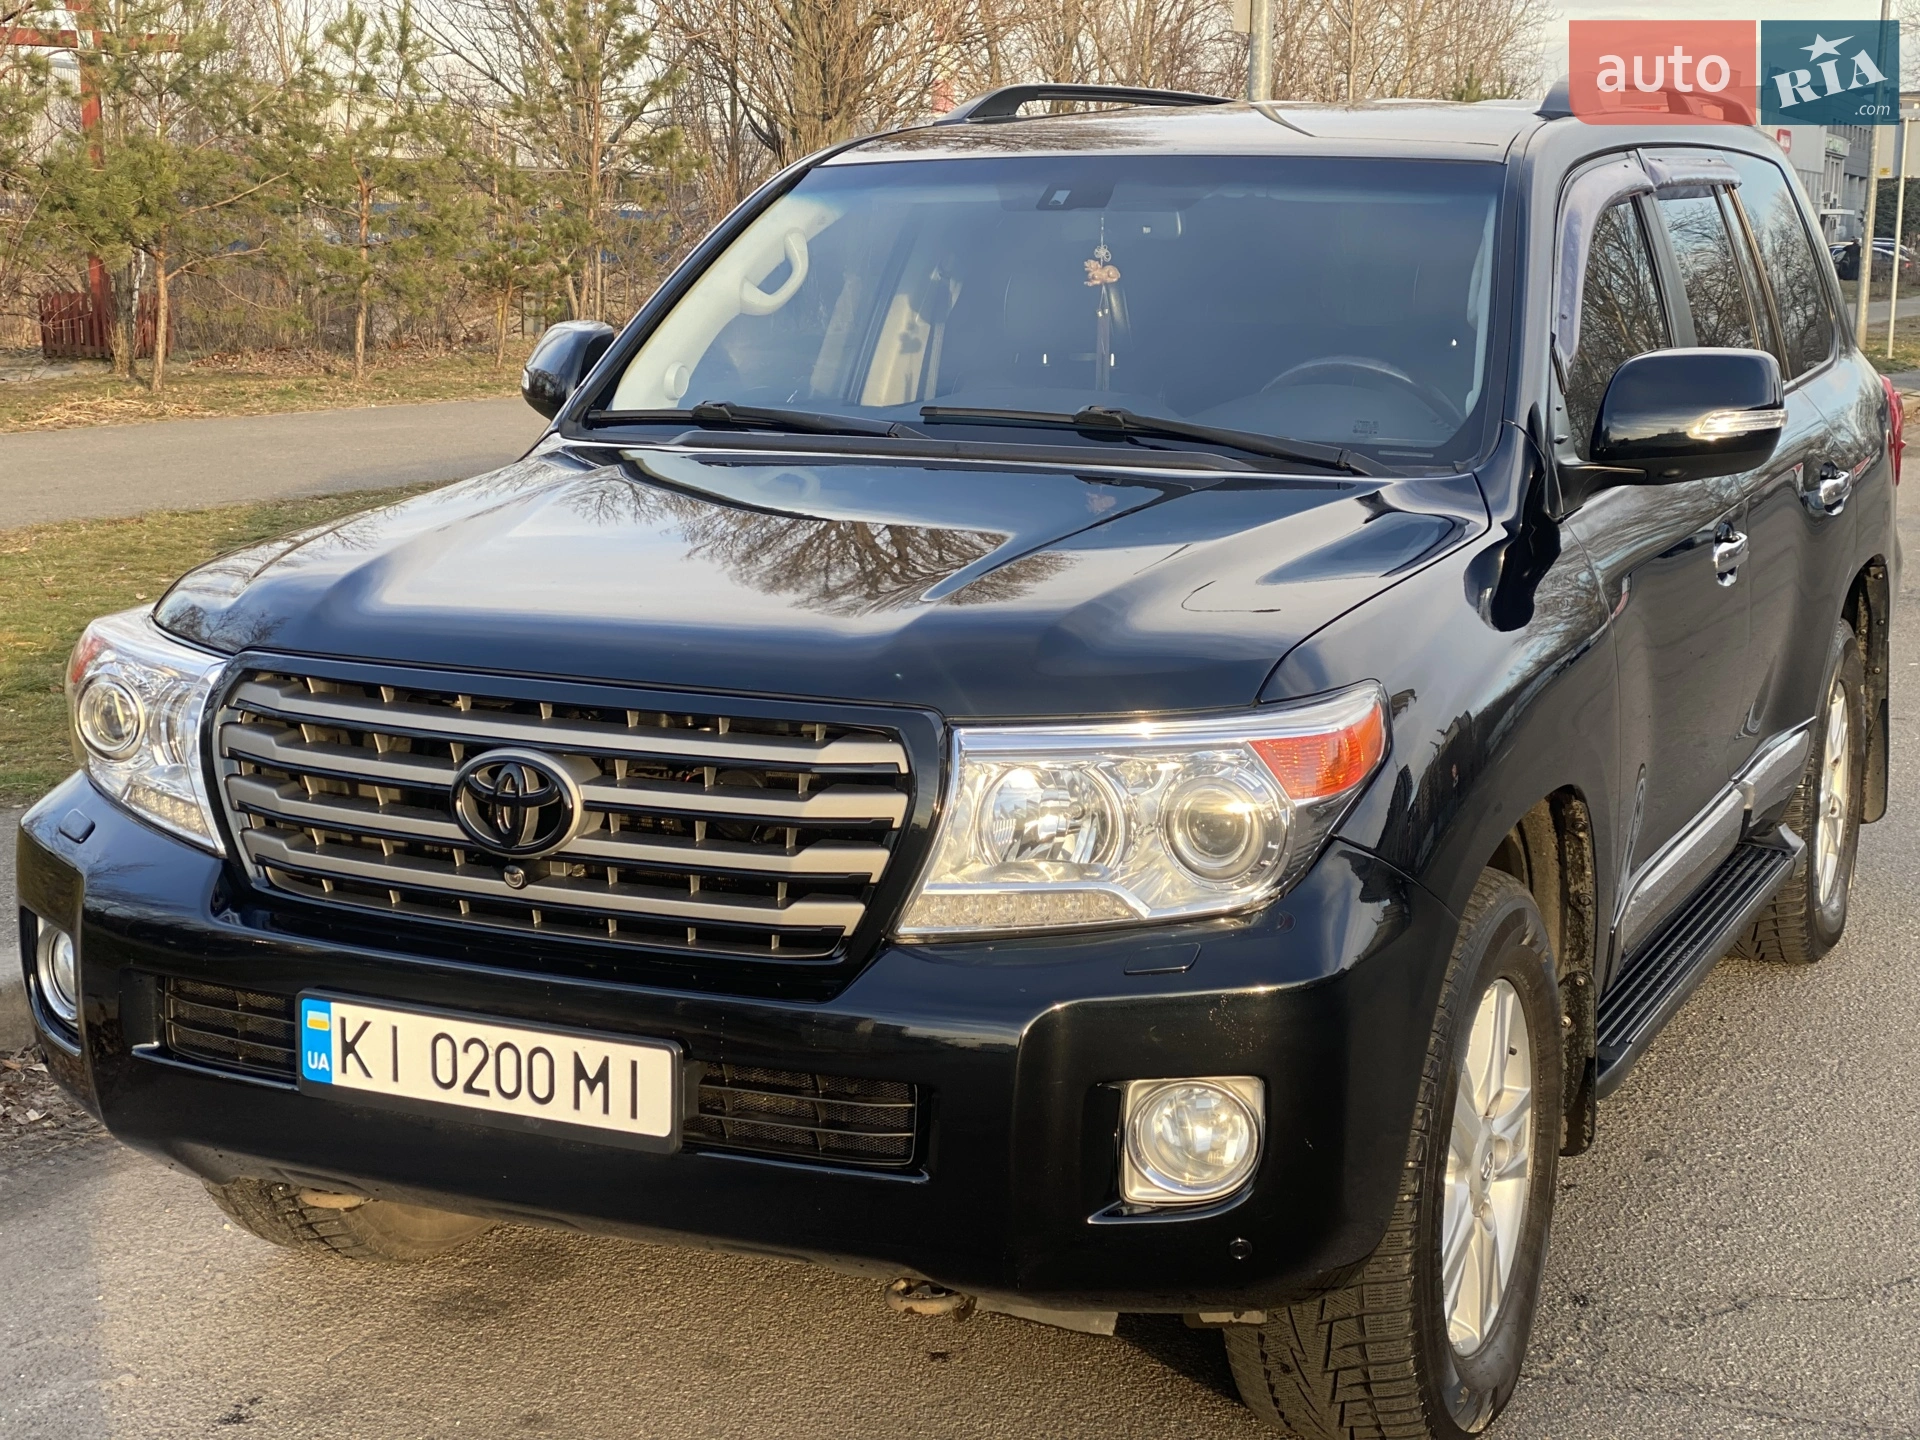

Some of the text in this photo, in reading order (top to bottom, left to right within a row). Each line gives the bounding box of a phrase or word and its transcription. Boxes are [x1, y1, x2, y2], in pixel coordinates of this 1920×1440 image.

[307, 1050, 330, 1072] UA
[340, 1016, 637, 1120] KI 0200 MI
